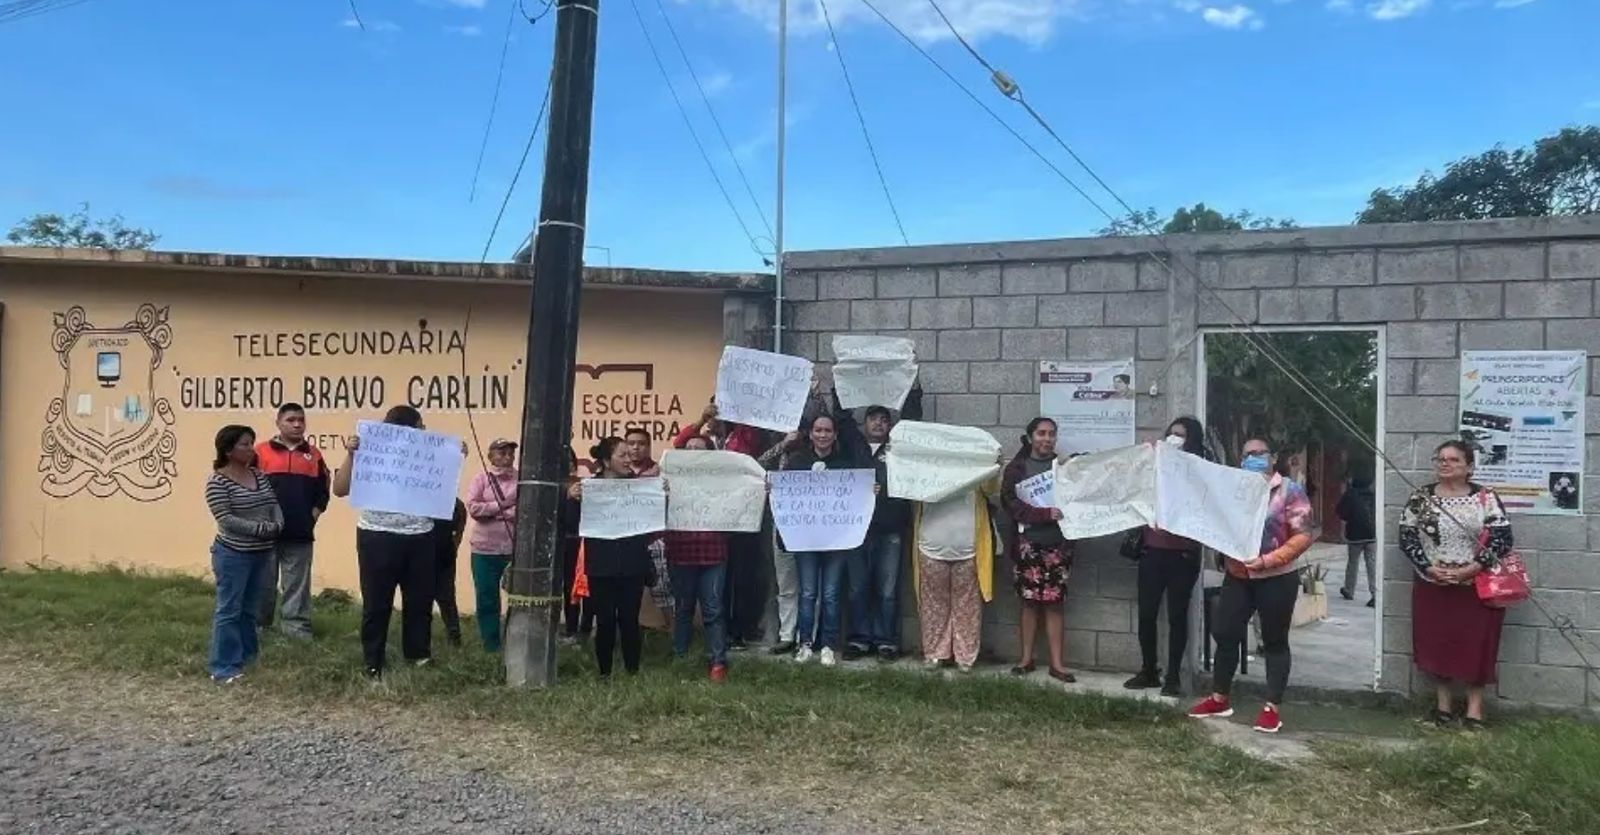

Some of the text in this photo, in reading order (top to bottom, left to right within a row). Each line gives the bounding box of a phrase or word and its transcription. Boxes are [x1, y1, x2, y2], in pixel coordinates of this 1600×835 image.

[233, 329, 465, 357] TELESECUNDARIA
[303, 375, 385, 409] BRAVO
[582, 393, 684, 416] ESCUELA
[581, 419, 681, 441] NUESTRA
